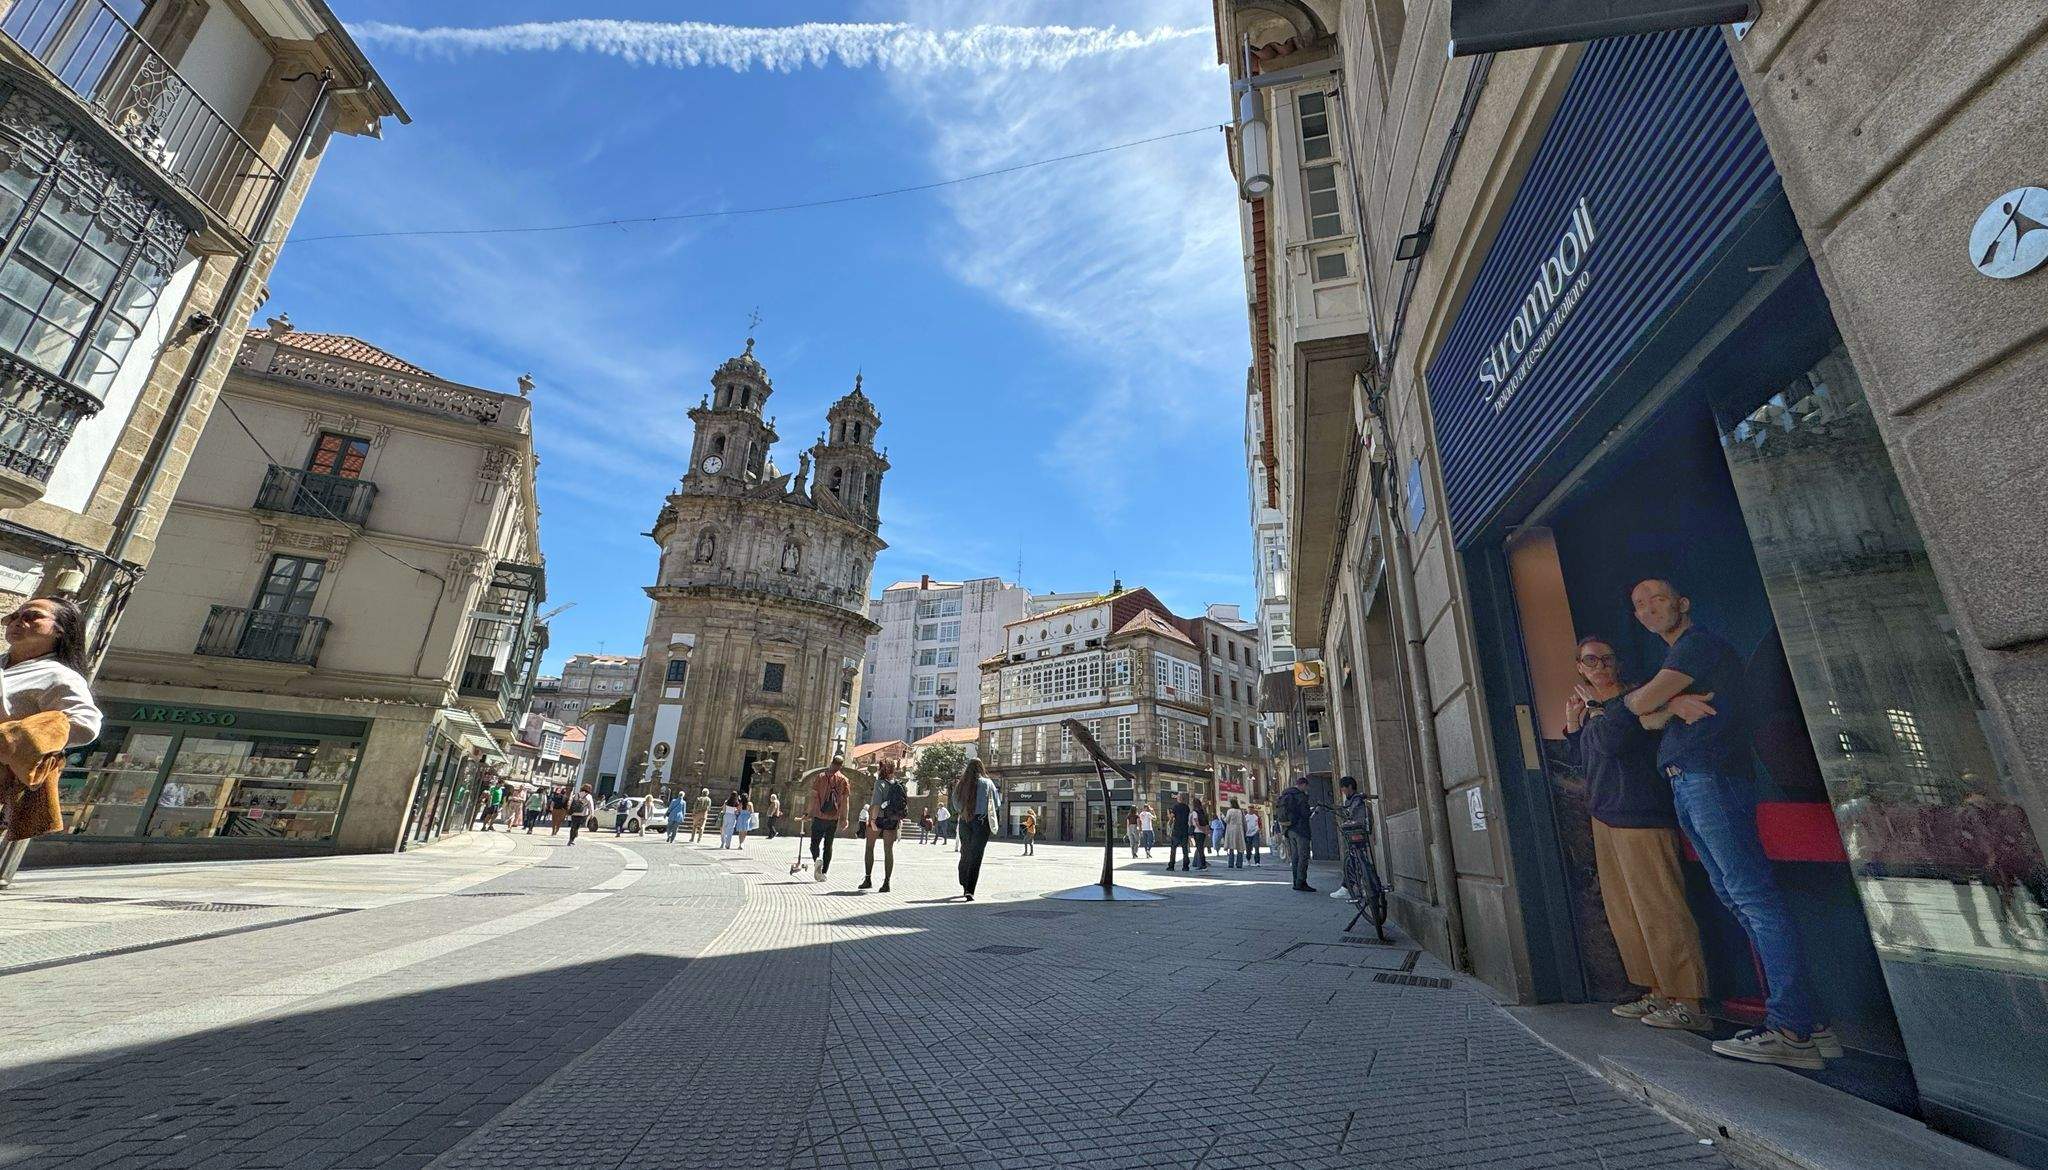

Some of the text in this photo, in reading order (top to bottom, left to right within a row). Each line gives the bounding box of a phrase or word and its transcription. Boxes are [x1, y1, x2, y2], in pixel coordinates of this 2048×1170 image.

[1479, 197, 1595, 402] stromboli
[1494, 270, 1590, 415] helado artesano italiano
[131, 704, 238, 727] ARESSO
